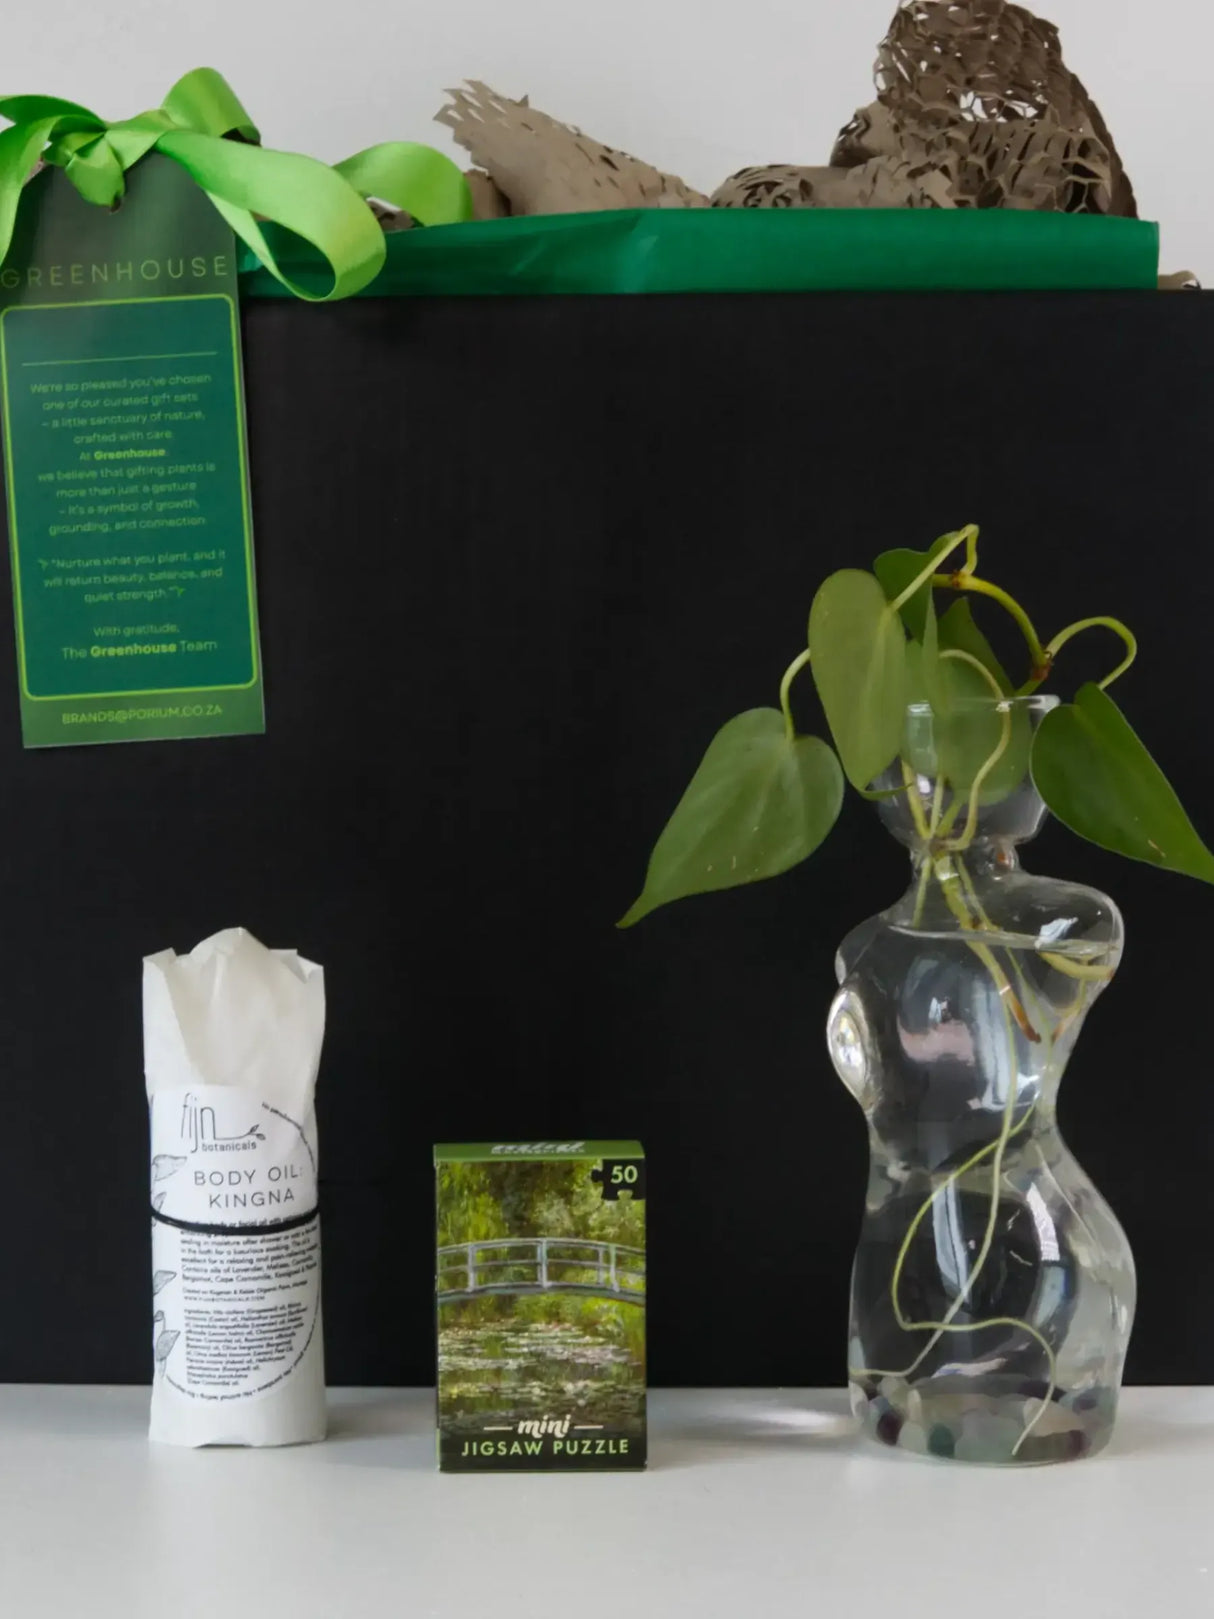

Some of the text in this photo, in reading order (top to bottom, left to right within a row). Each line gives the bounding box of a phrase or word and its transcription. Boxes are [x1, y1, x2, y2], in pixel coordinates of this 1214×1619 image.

[1, 255, 228, 288] GREENHOUSE
[65, 384, 79, 393] so
[81, 379, 127, 393] pleased
[168, 374, 212, 386] chosen
[42, 393, 198, 411] one of our curated gift sets
[61, 415, 88, 428] little
[90, 413, 148, 427] sanctuary
[151, 411, 163, 421] of
[73, 433, 116, 445] crafted
[119, 430, 144, 441] with
[38, 462, 216, 482] we believe that gifting plants is
[56, 487, 87, 498] more
[89, 485, 115, 496] than
[117, 483, 139, 496] just
[151, 481, 197, 494] gesture
[97, 501, 139, 515] symbol
[141, 500, 153, 511] of
[115, 519, 137, 530] and
[103, 555, 131, 566] what
[134, 555, 155, 567] you
[193, 550, 216, 561] and
[218, 549, 226, 559] it
[43, 576, 63, 587] will
[65, 574, 101, 586] return
[201, 567, 223, 579] and
[84, 591, 115, 604] quiet
[93, 626, 121, 638] With
[62, 639, 218, 660] The Greenhouse Team
[202, 1141, 257, 1152] botanicals
[194, 1169, 256, 1186] BODY
[610, 1165, 638, 1184] 50
[209, 1188, 295, 1208] KINGNA
[518, 1414, 571, 1438] mini
[461, 1439, 629, 1457] JIGSAW PUZZLE
